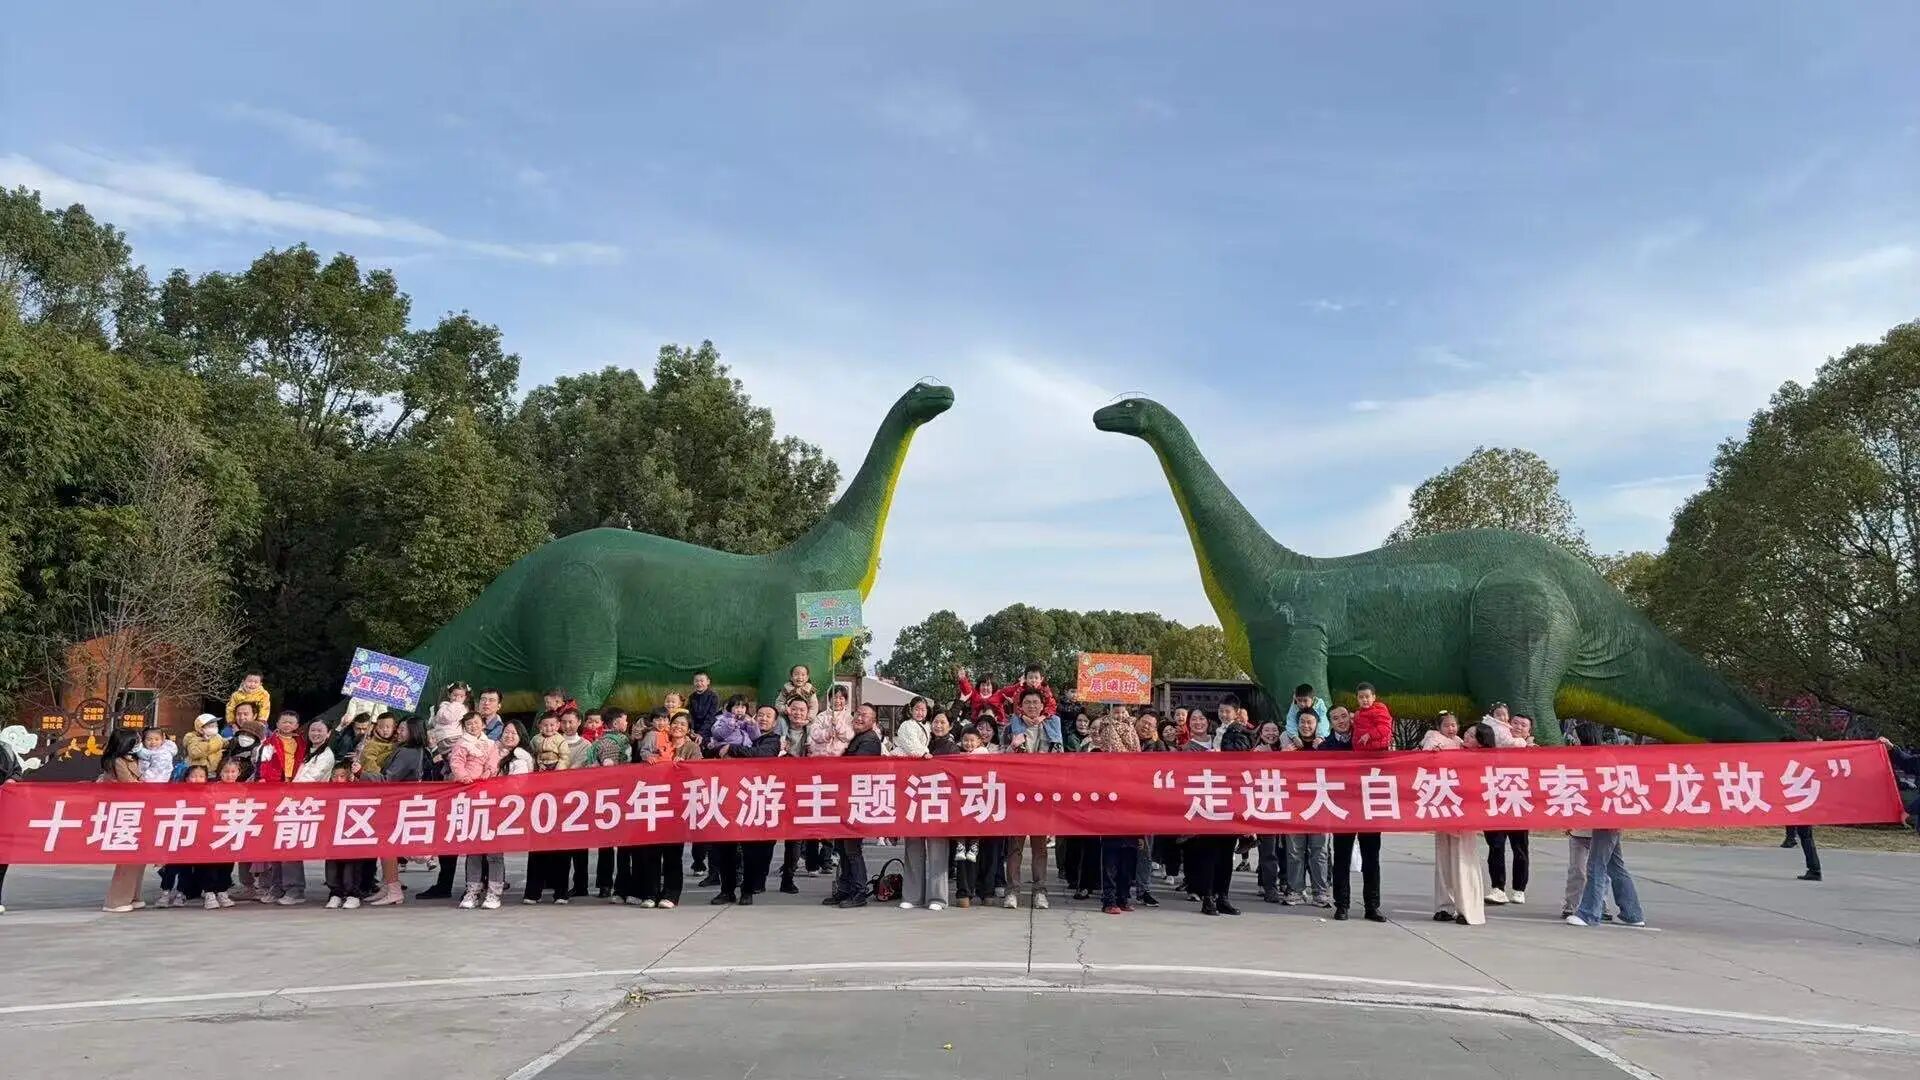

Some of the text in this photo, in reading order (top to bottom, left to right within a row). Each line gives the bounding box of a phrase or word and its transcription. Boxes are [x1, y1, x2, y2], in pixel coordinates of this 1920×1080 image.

[807, 615, 851, 630] 云朵班
[358, 676, 408, 699] 星辰班
[1090, 677, 1138, 694] 晨曦班
